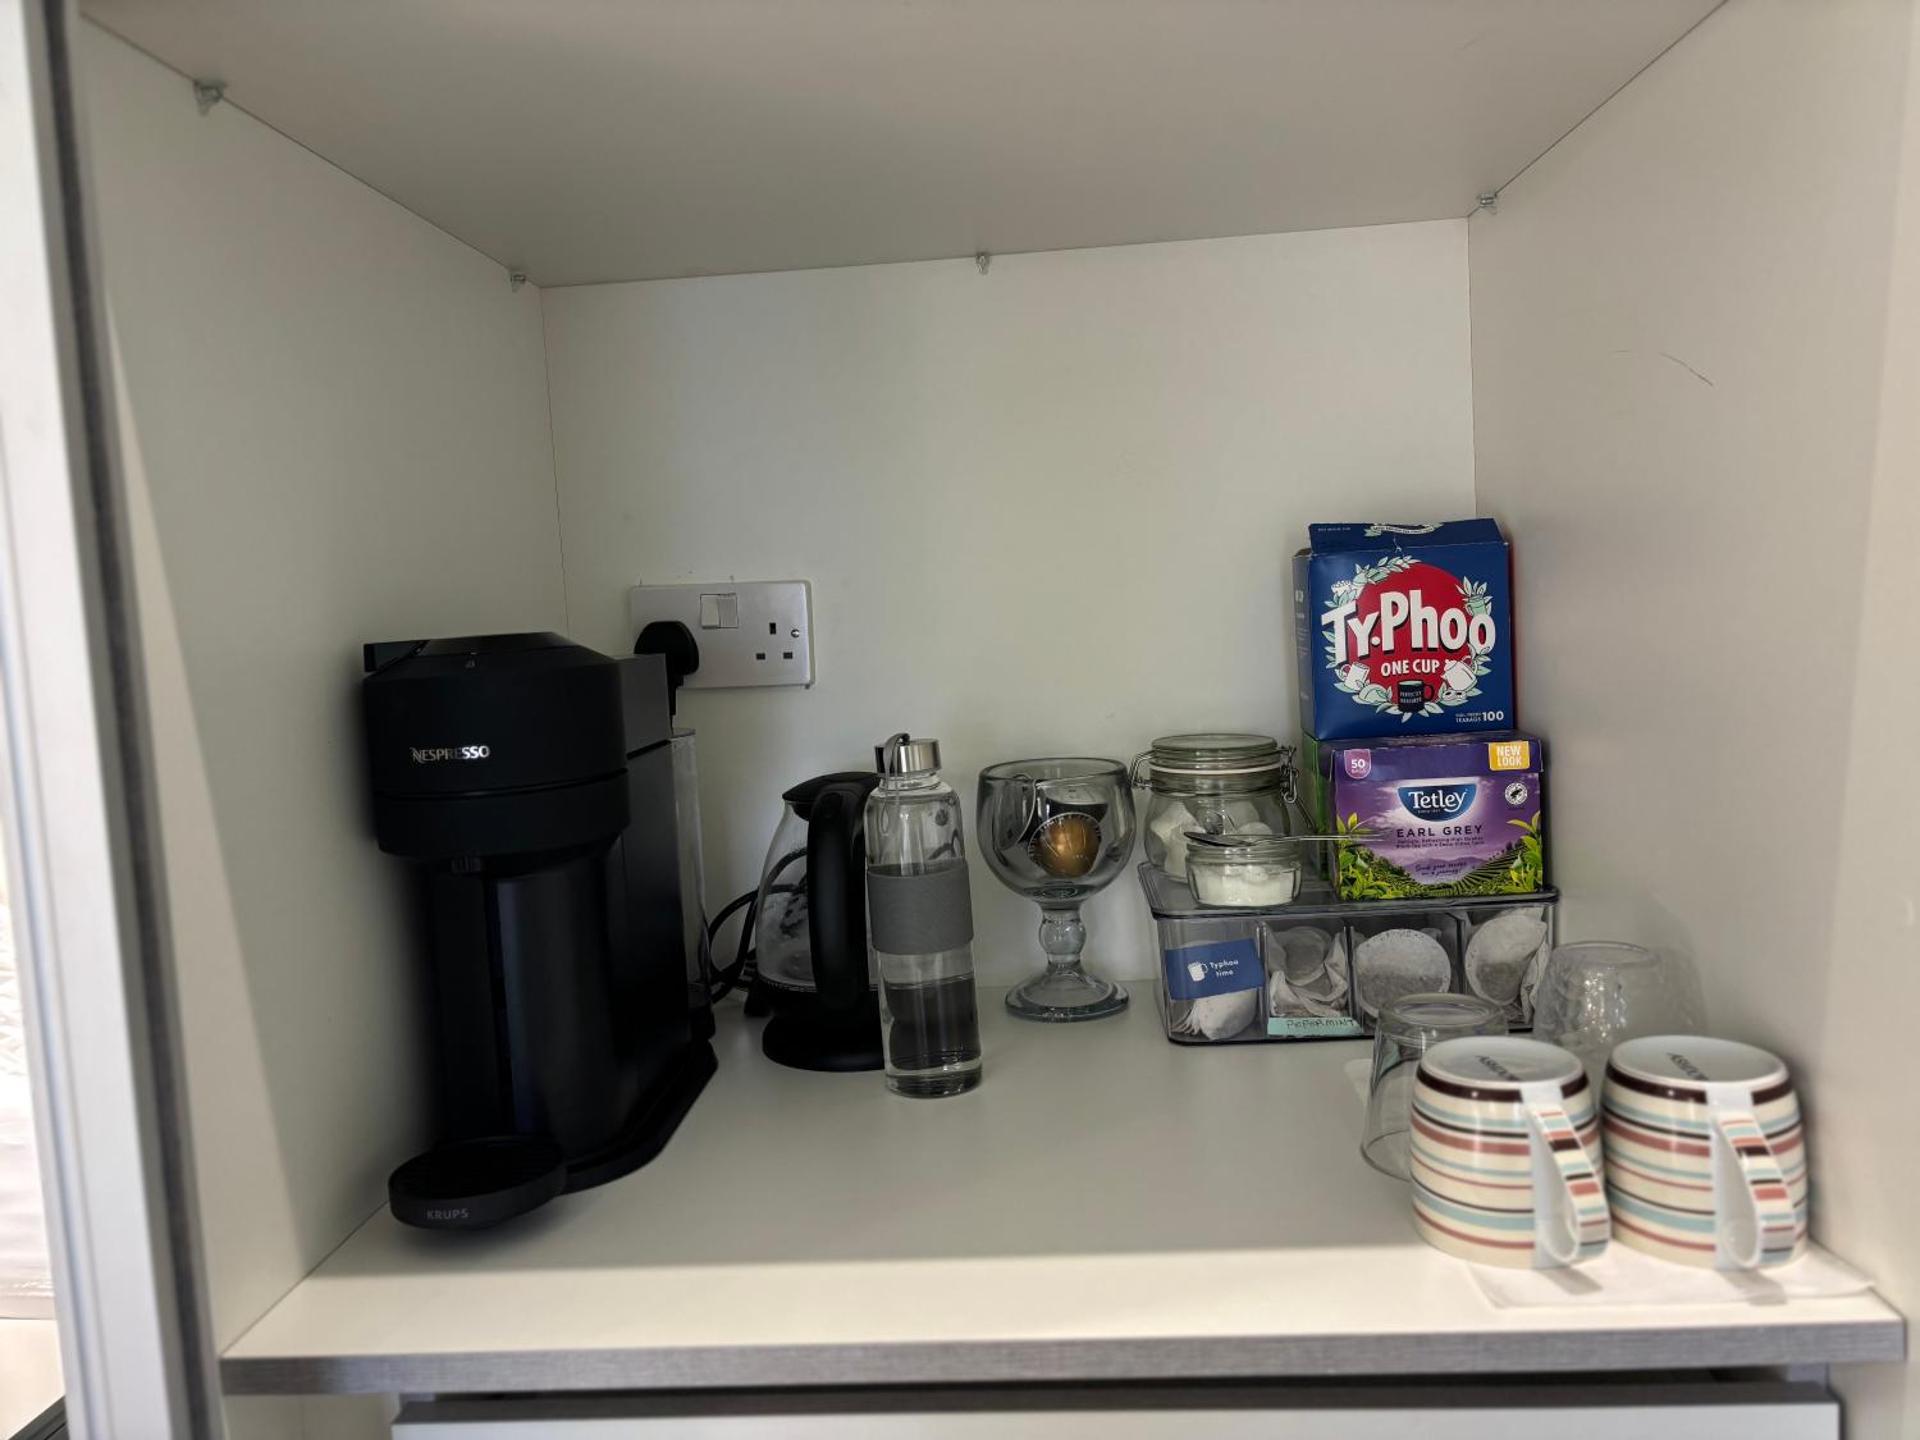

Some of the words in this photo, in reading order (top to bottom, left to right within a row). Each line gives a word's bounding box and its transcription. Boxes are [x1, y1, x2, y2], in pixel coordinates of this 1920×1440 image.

[1380, 660, 1410, 677] ONE
[1412, 658, 1440, 674] CUP
[1482, 710, 1505, 722] 100
[408, 744, 491, 764] NESPRESSO
[1496, 744, 1521, 756] NEW
[1351, 758, 1366, 769] 50
[1497, 755, 1522, 767] LOOK
[1407, 789, 1467, 813] Tetley
[1396, 827, 1435, 838] EARL
[1442, 825, 1483, 836] GREY
[426, 1208, 469, 1220] KRUPS
